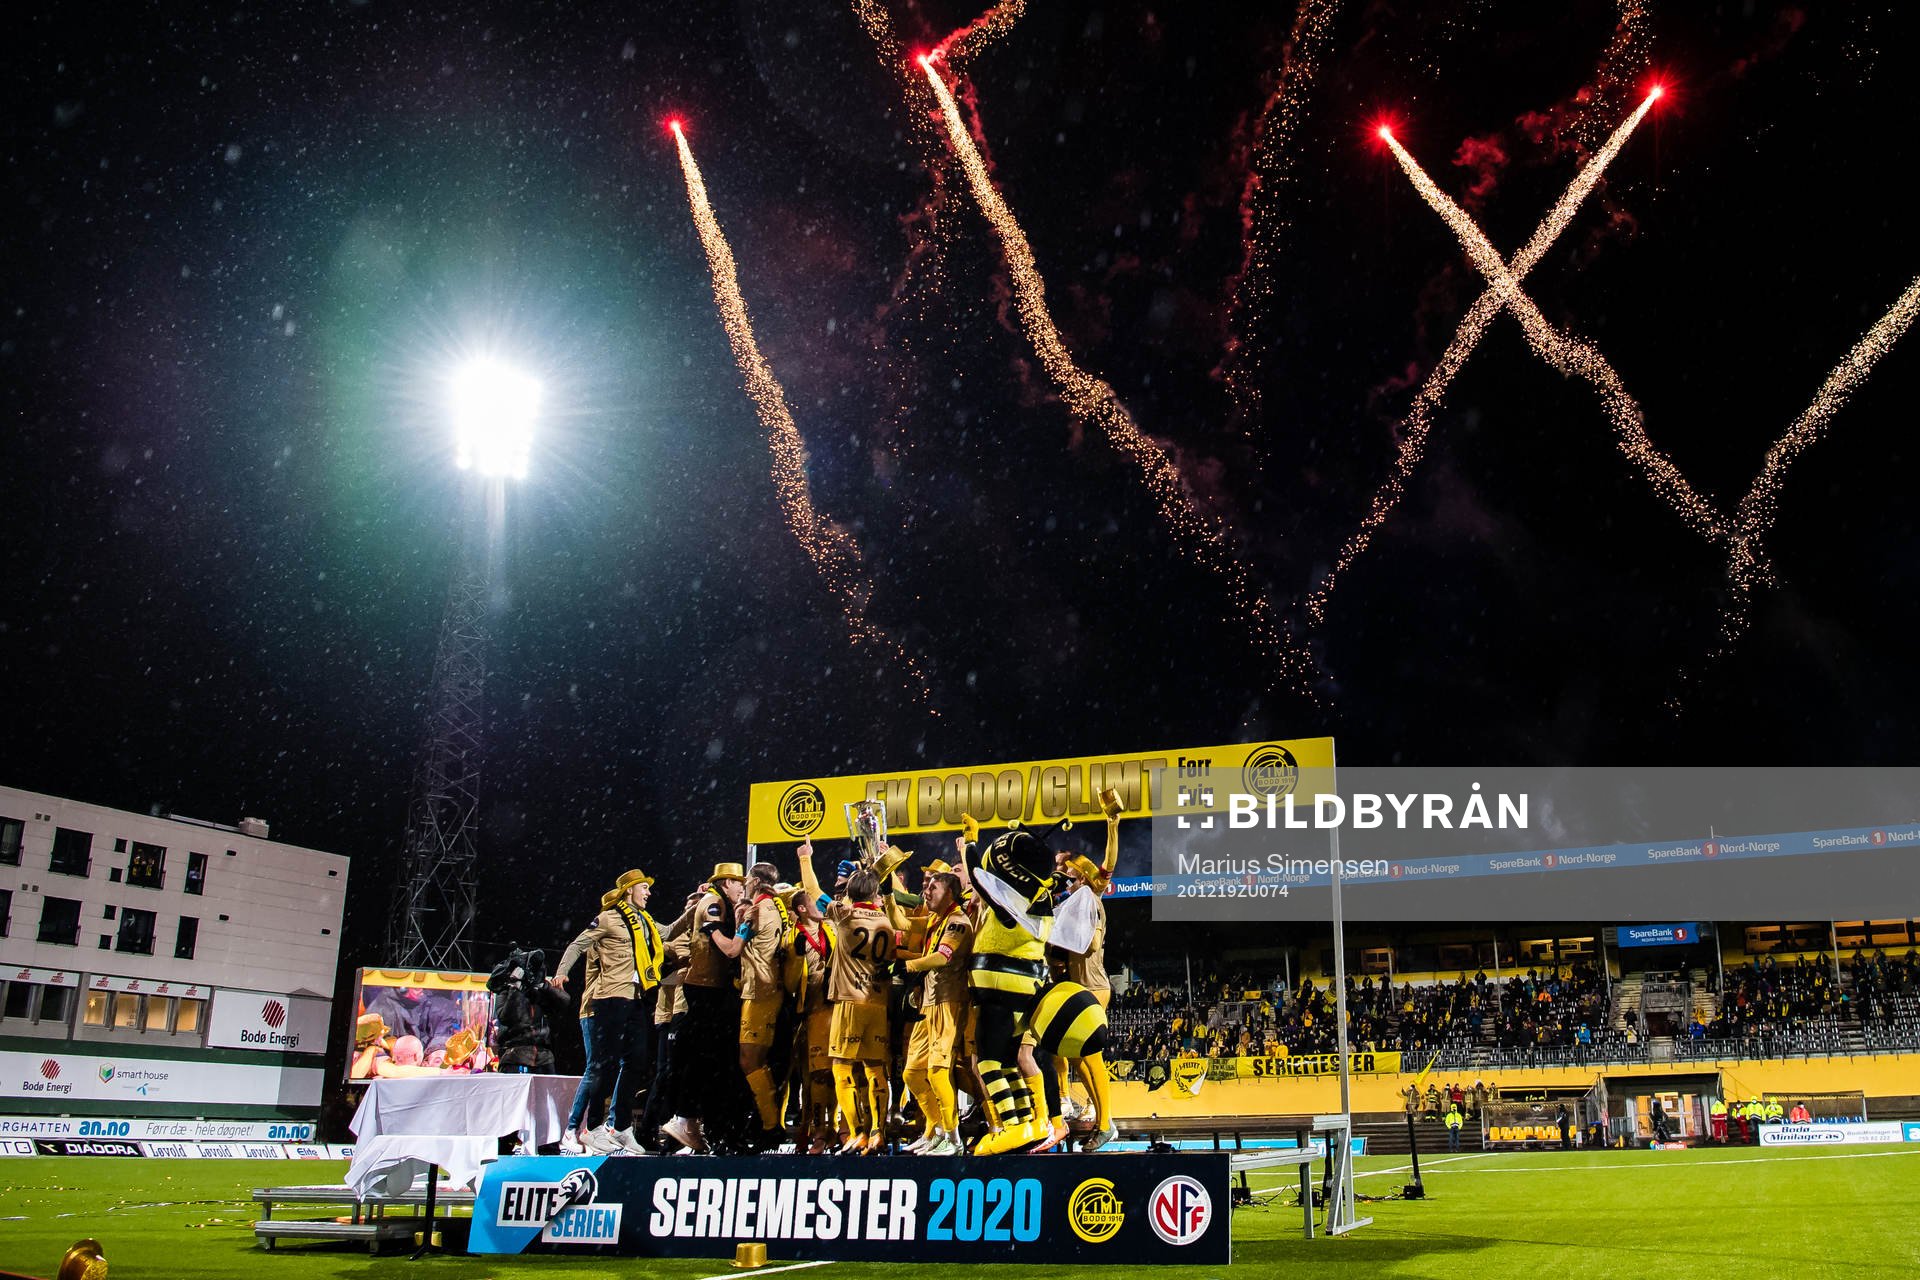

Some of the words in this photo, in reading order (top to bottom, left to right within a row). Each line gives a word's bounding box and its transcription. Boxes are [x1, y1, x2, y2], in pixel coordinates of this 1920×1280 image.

[1178, 756, 1212, 779] Førr
[1812, 834, 1869, 848] SpareBank
[1888, 827, 1920, 842] Nord-
[1647, 845, 1702, 860] SpareBank
[1719, 841, 1780, 854] Nord-Norge
[1489, 857, 1541, 870] SpareBank
[1558, 852, 1617, 866] Nord-Norge
[1404, 862, 1460, 875] Nord-Norge
[1257, 872, 1310, 885] Nord-Norge
[1117, 881, 1168, 894] Nord-Norge
[1629, 927, 1673, 939] SpareBank
[851, 926, 889, 963] 20
[241, 1029, 266, 1043] Bodø
[270, 1031, 300, 1048] Energi
[117, 1070, 142, 1079] smart
[143, 1069, 169, 1080] house
[23, 1081, 44, 1092] Bodø
[46, 1082, 73, 1095] Energi
[0, 1121, 71, 1133] RGHATTEN
[79, 1121, 130, 1137] an.no
[195, 1125, 215, 1136] hele
[217, 1125, 255, 1139] døgnet!
[268, 1125, 310, 1139] an.no
[65, 1143, 138, 1156] DIADORA
[149, 1144, 187, 1157] Løvold
[197, 1144, 233, 1158] Løvold
[243, 1145, 279, 1158] Løvold
[503, 1186, 561, 1223] ELITE
[650, 1177, 918, 1241] SERIEMESTER
[926, 1177, 1042, 1242] 2020
[550, 1209, 617, 1239] SERIEN
